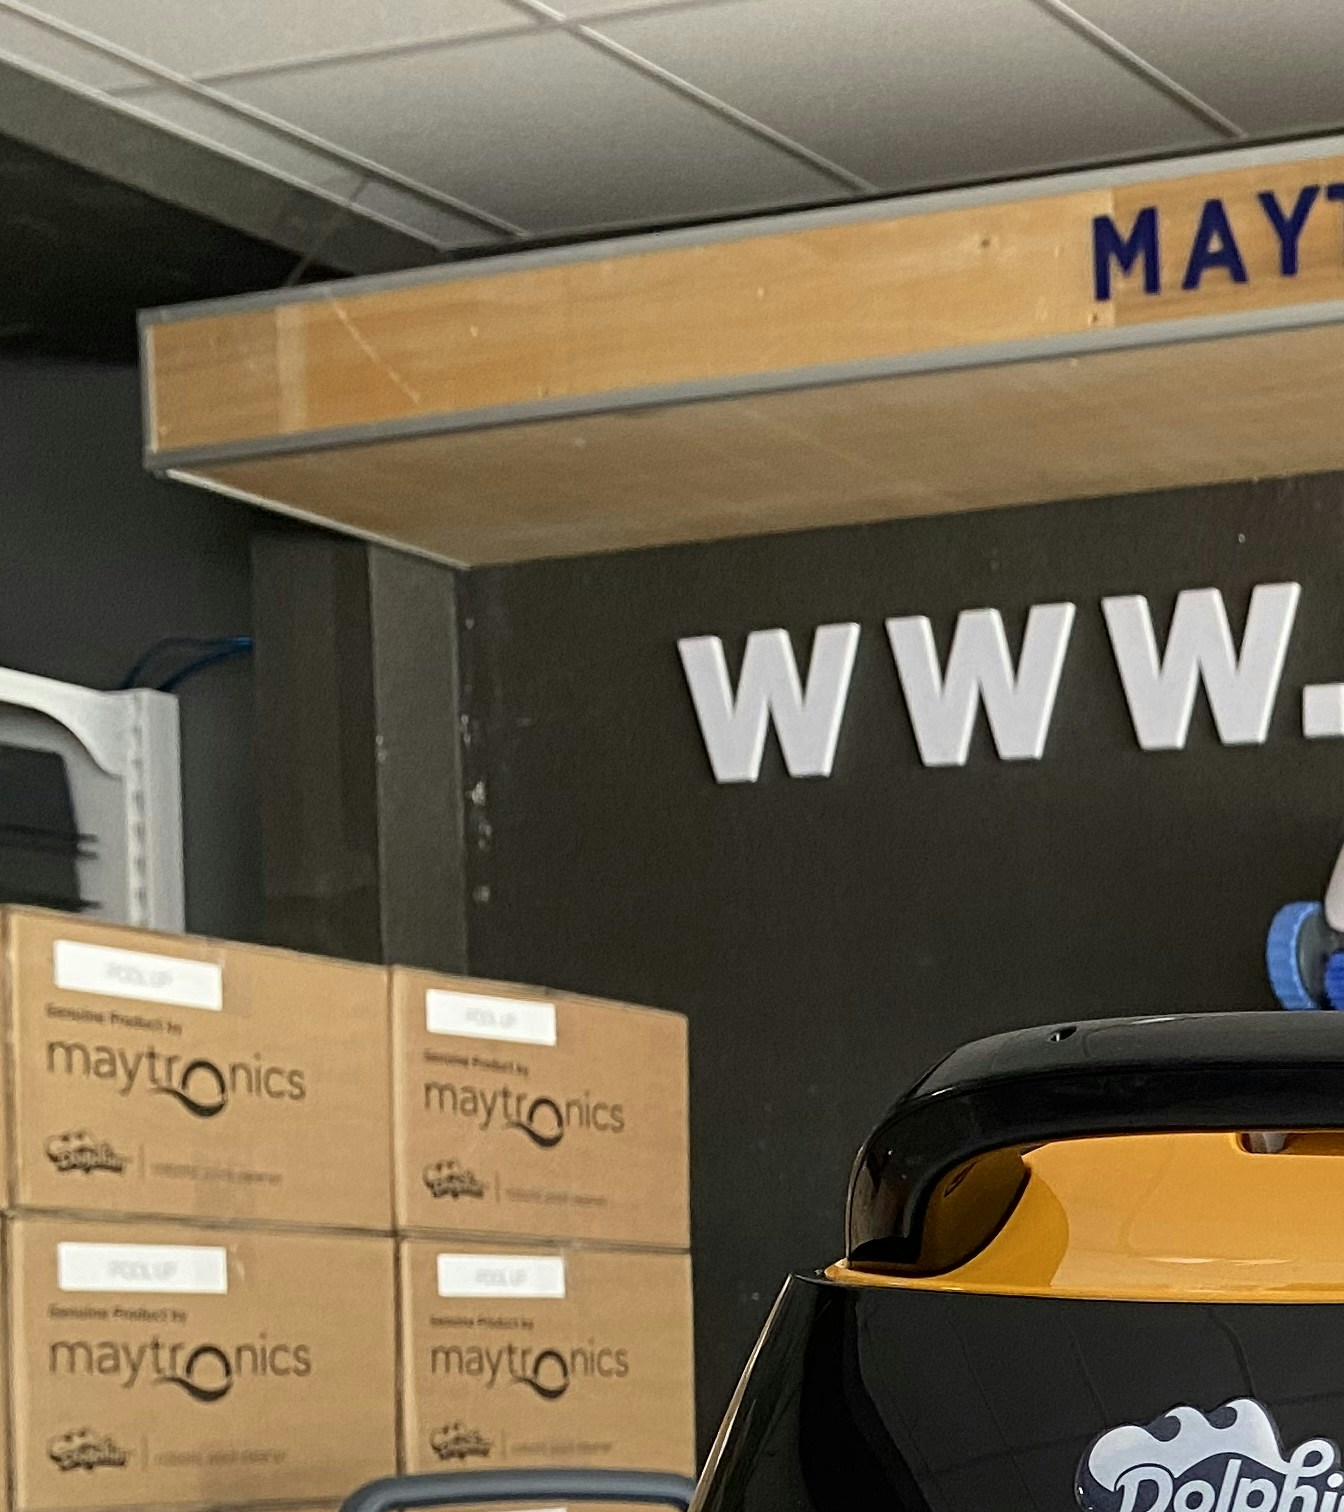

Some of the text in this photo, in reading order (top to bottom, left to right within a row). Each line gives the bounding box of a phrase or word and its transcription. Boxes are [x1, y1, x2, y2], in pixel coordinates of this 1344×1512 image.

[46, 1040, 307, 1118] maytronics
[424, 1082, 625, 1149] maytronics
[48, 1331, 312, 1403] maytronics
[430, 1337, 629, 1400] maytronics
